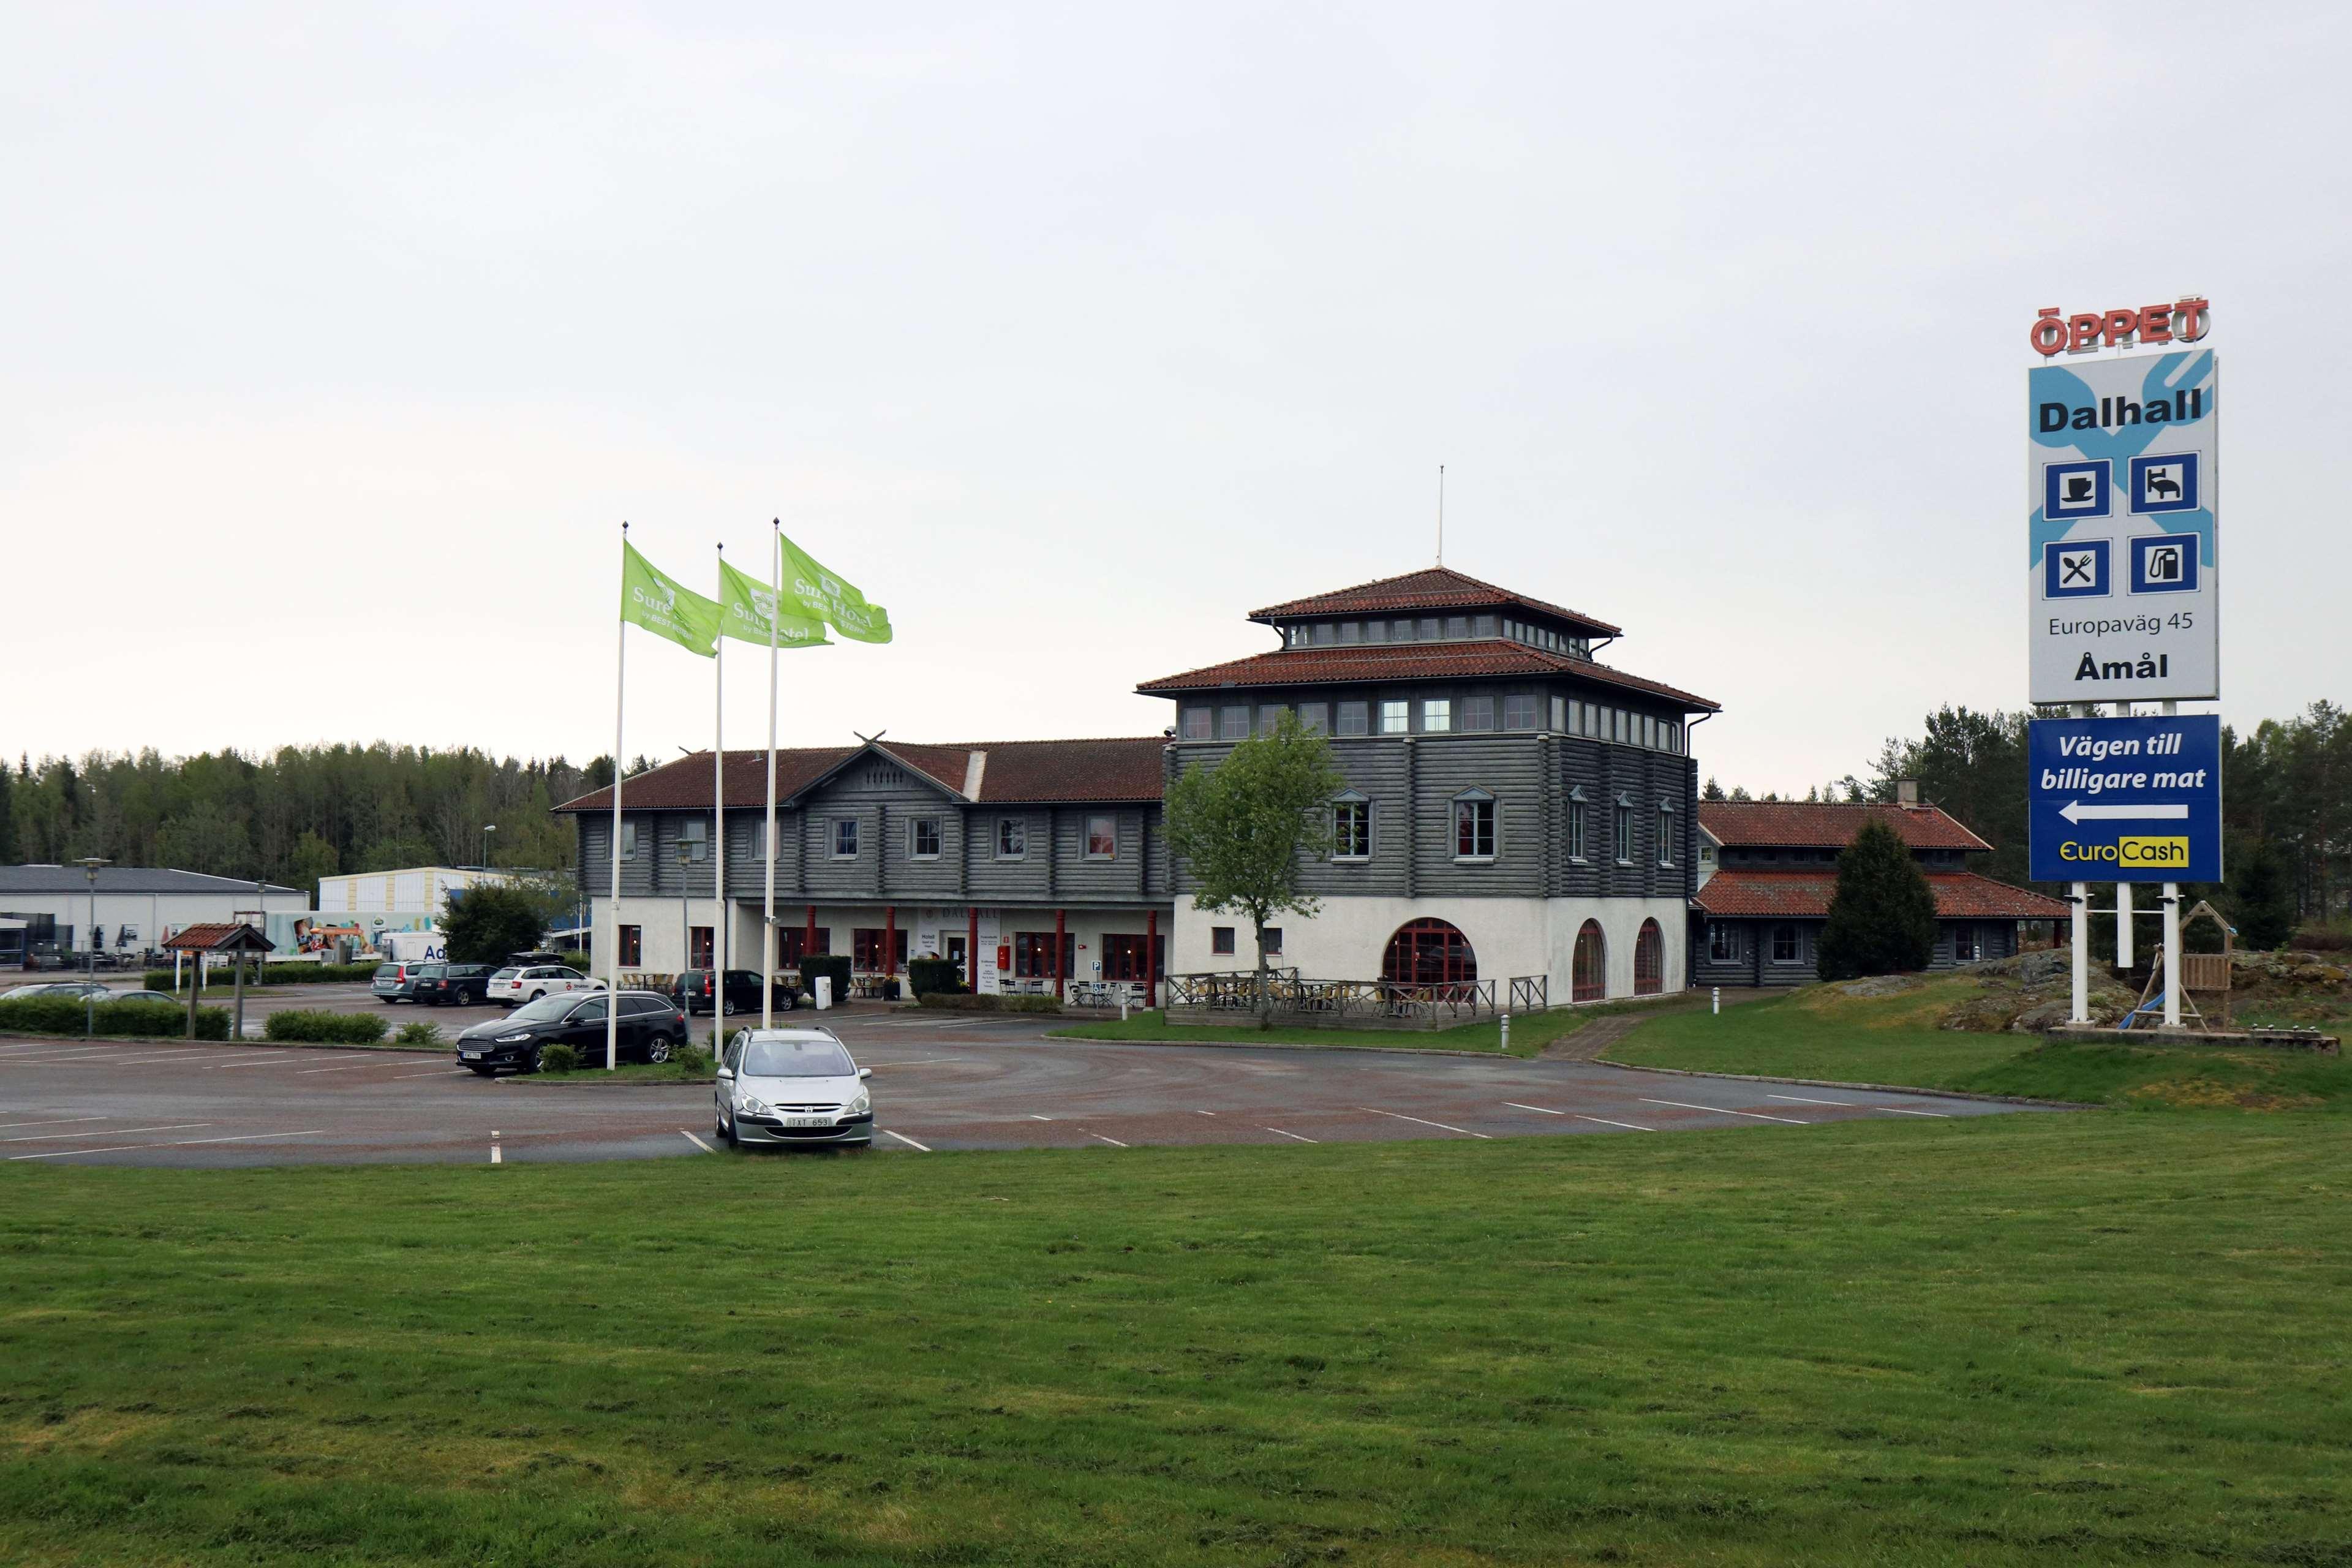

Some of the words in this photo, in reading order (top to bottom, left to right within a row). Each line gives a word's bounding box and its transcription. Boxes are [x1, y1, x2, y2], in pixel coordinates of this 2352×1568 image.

[2030, 300, 2209, 355] ÖPPET
[2040, 388, 2201, 434] Dalhall
[633, 586, 672, 616] Sure
[795, 578, 829, 603] Sure
[650, 614, 671, 628] BEST
[2049, 614, 2161, 638] Europaväg
[2167, 612, 2193, 630] 45
[2074, 652, 2168, 681] Åmål
[2059, 735, 2141, 761] Vägen
[2146, 733, 2182, 755] till
[2040, 768, 2146, 794] billigare
[2152, 769, 2207, 788] mat
[2059, 840, 2185, 862] EuroCash
